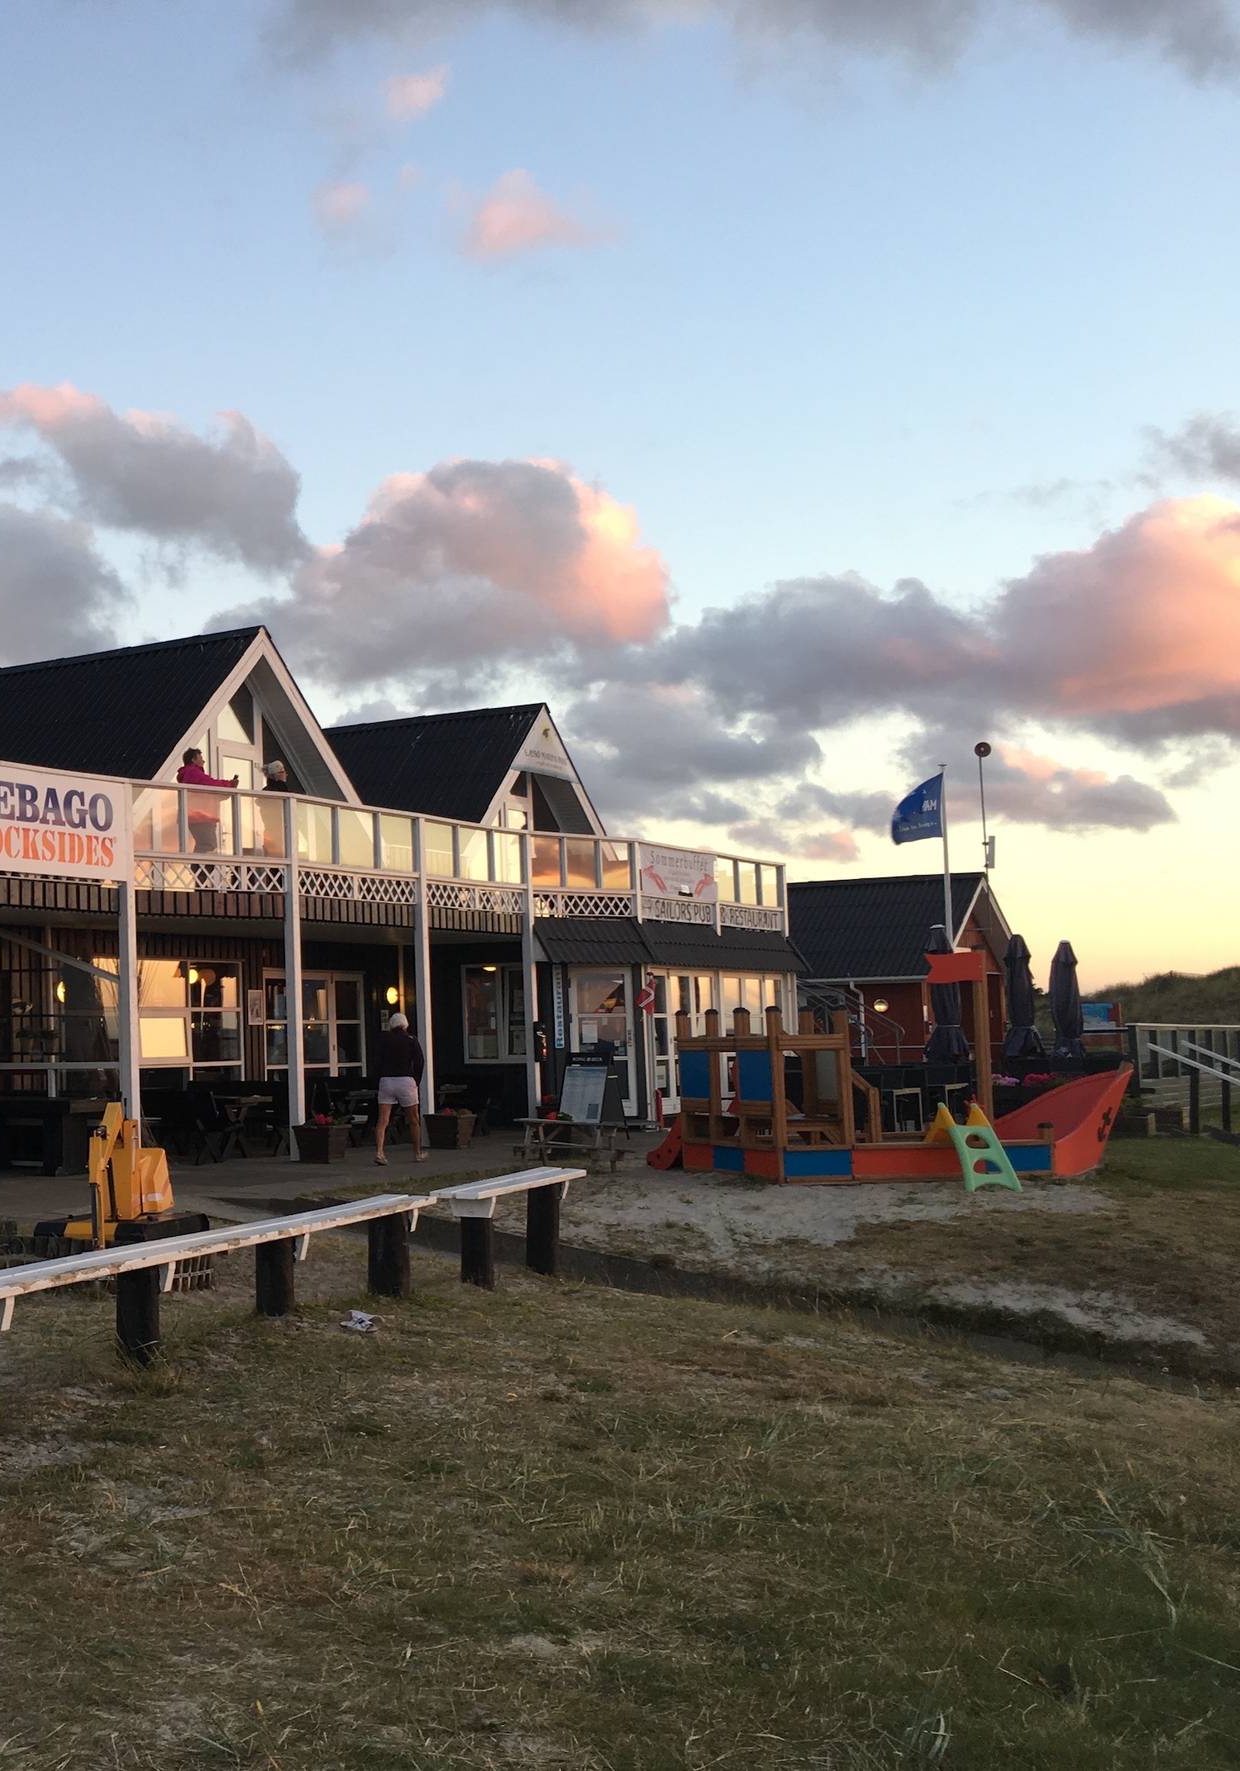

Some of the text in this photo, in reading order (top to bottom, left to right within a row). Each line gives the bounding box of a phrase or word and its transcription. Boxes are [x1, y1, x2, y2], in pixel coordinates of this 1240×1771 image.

[654, 900, 692, 921] SAILORS
[694, 904, 711, 922] PUB
[729, 909, 779, 929] RESTAURANT
